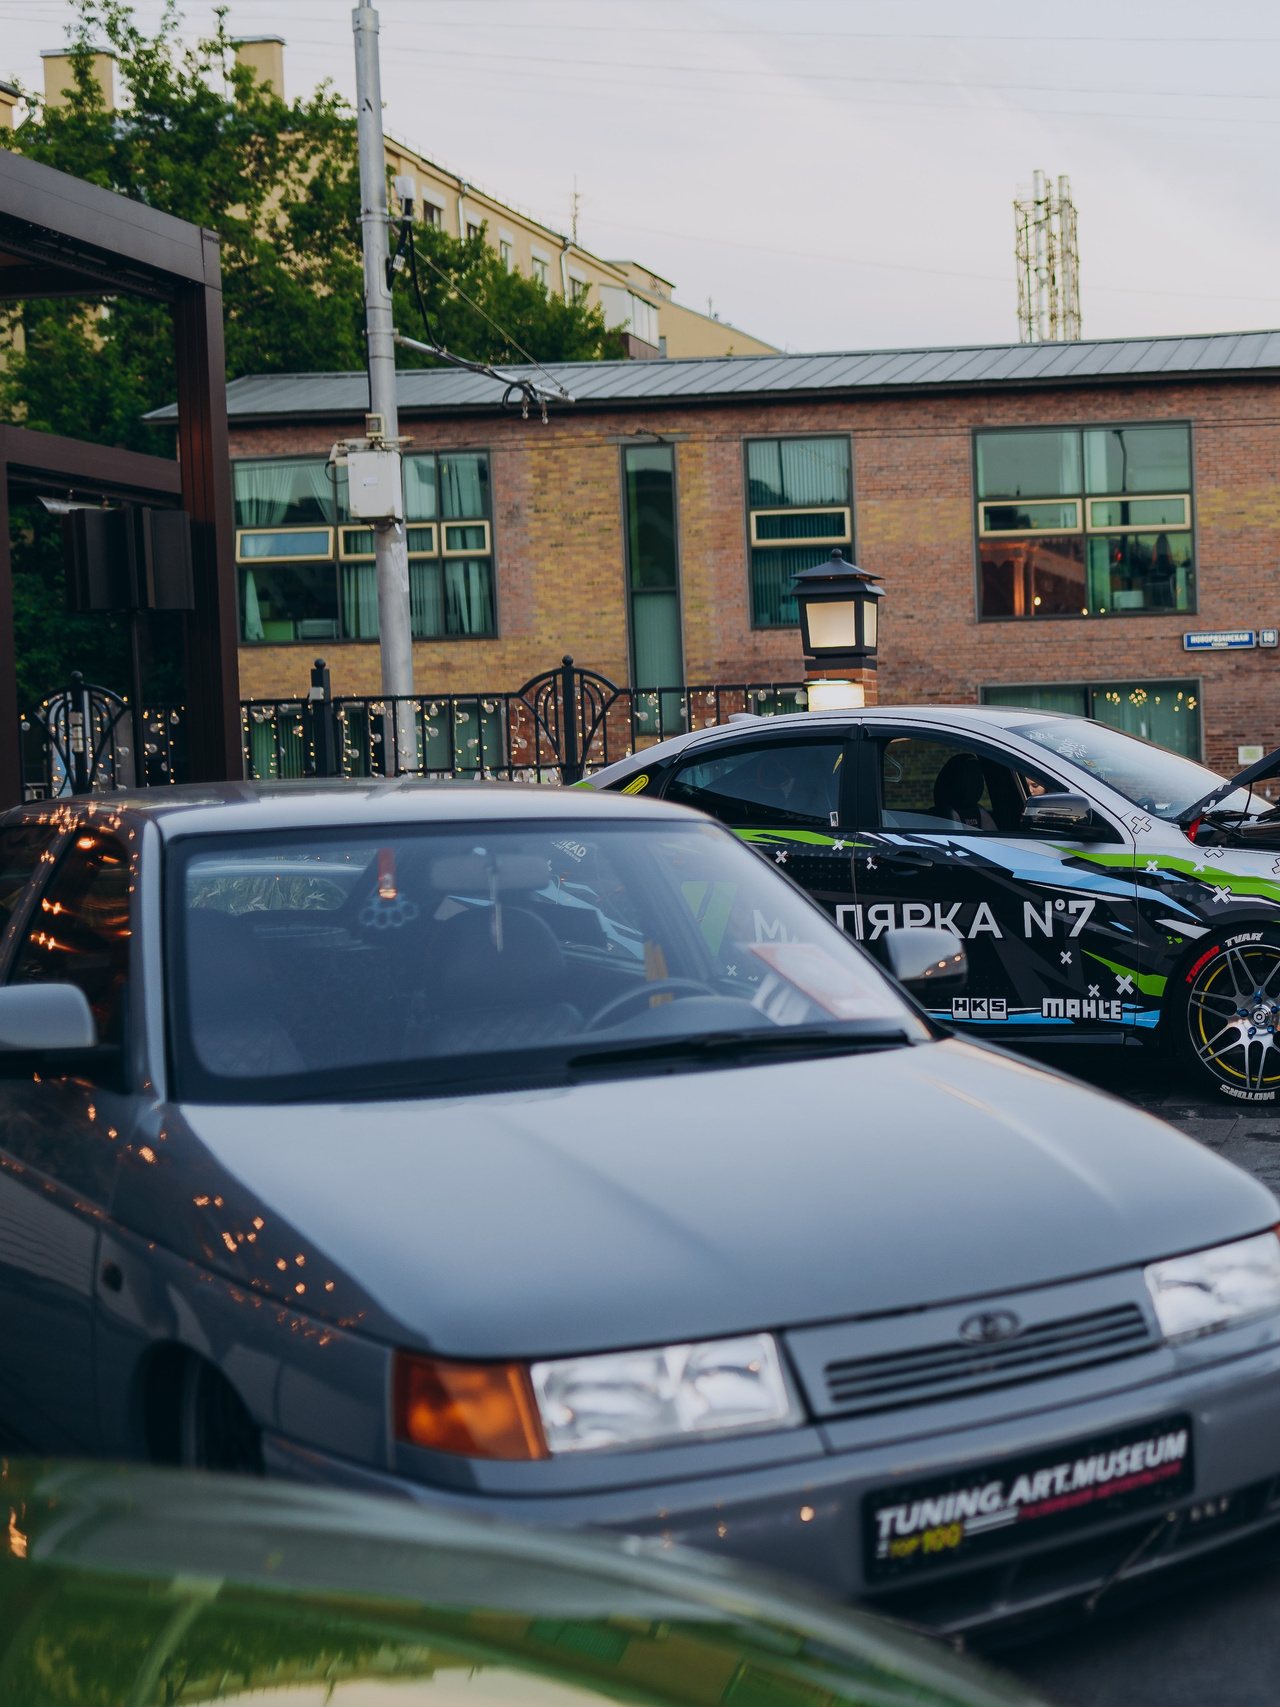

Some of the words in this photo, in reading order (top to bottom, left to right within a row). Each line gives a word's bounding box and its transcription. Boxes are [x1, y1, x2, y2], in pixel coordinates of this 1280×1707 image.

[1263, 632, 1275, 643] 18
[1185, 945, 1220, 984] TURBO
[953, 997, 1008, 1019] HKS
[1042, 998, 1122, 1019] MAHLE
[1220, 1084, 1276, 1100] MOTORS
[922, 1522, 963, 1555] 100
